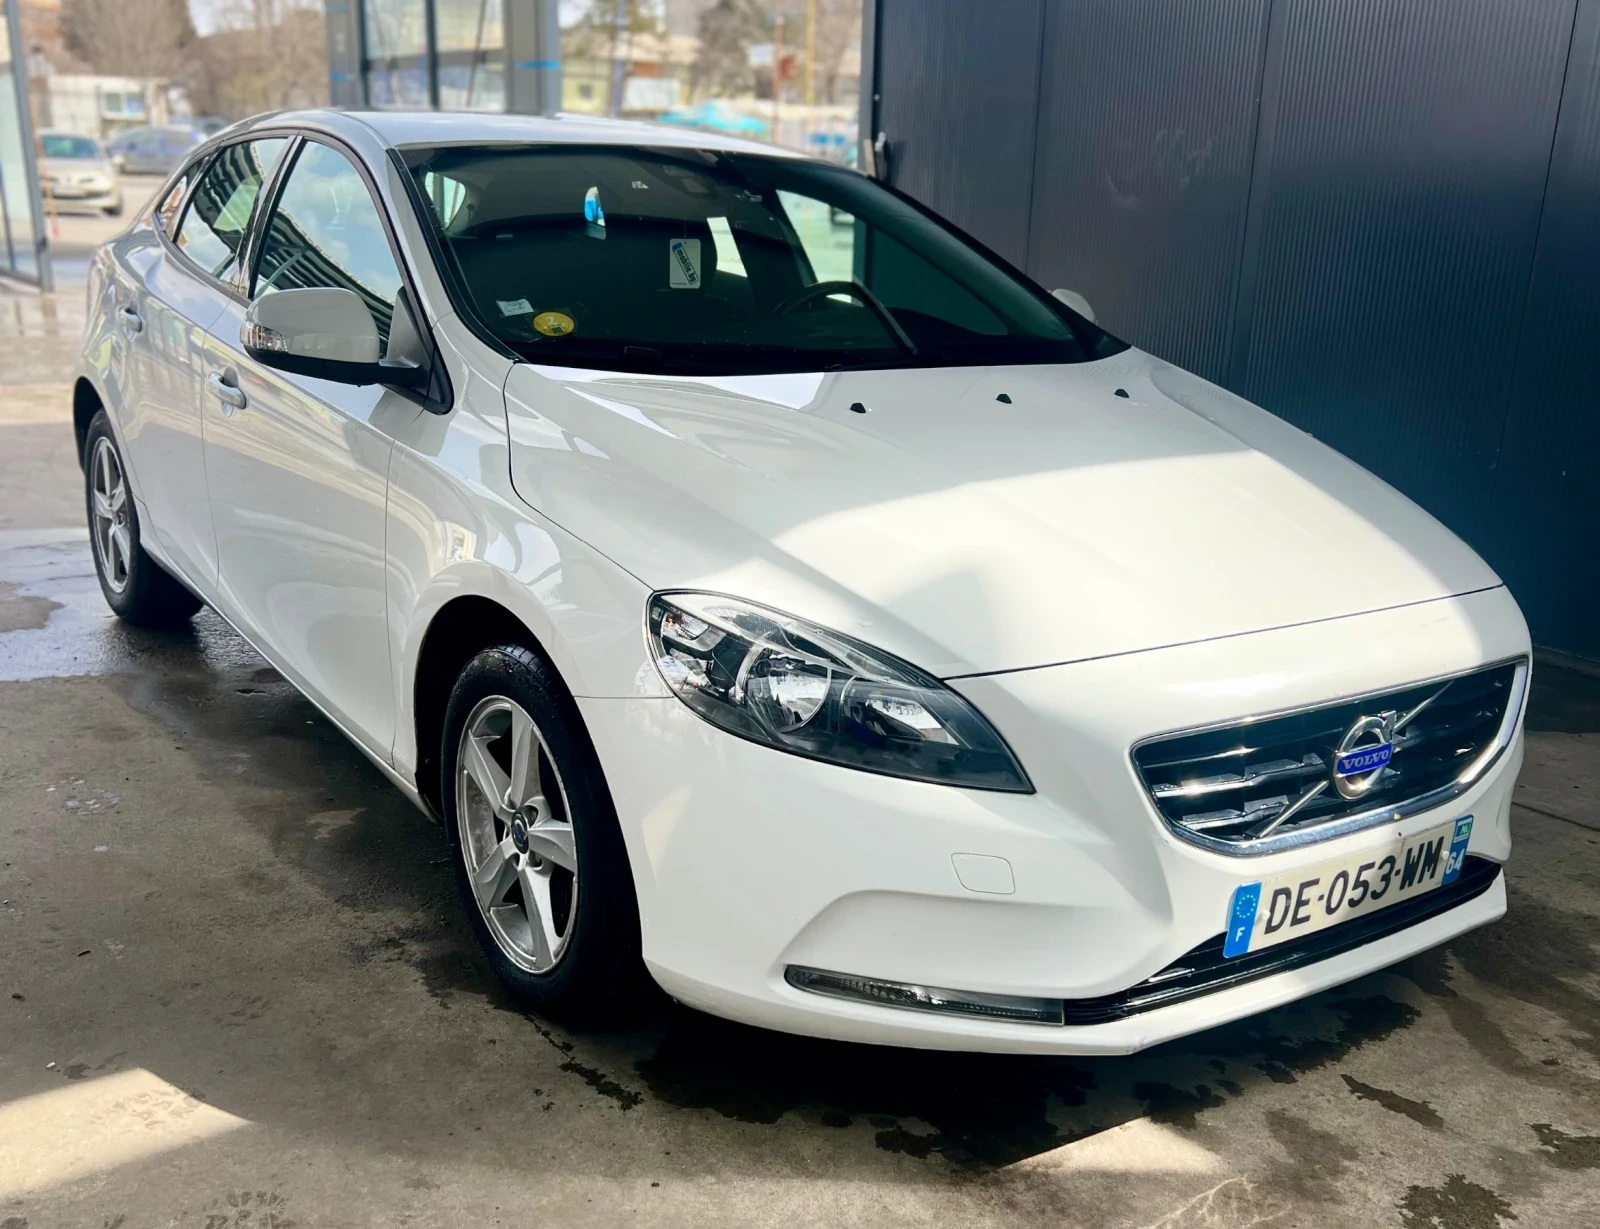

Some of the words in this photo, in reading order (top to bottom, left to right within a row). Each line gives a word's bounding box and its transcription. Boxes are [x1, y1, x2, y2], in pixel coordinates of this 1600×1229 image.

[1342, 749, 1389, 770] VOLVO
[1445, 847, 1466, 875] 64
[1264, 835, 1445, 935] DE-053-WM
[1235, 926, 1246, 943] F
